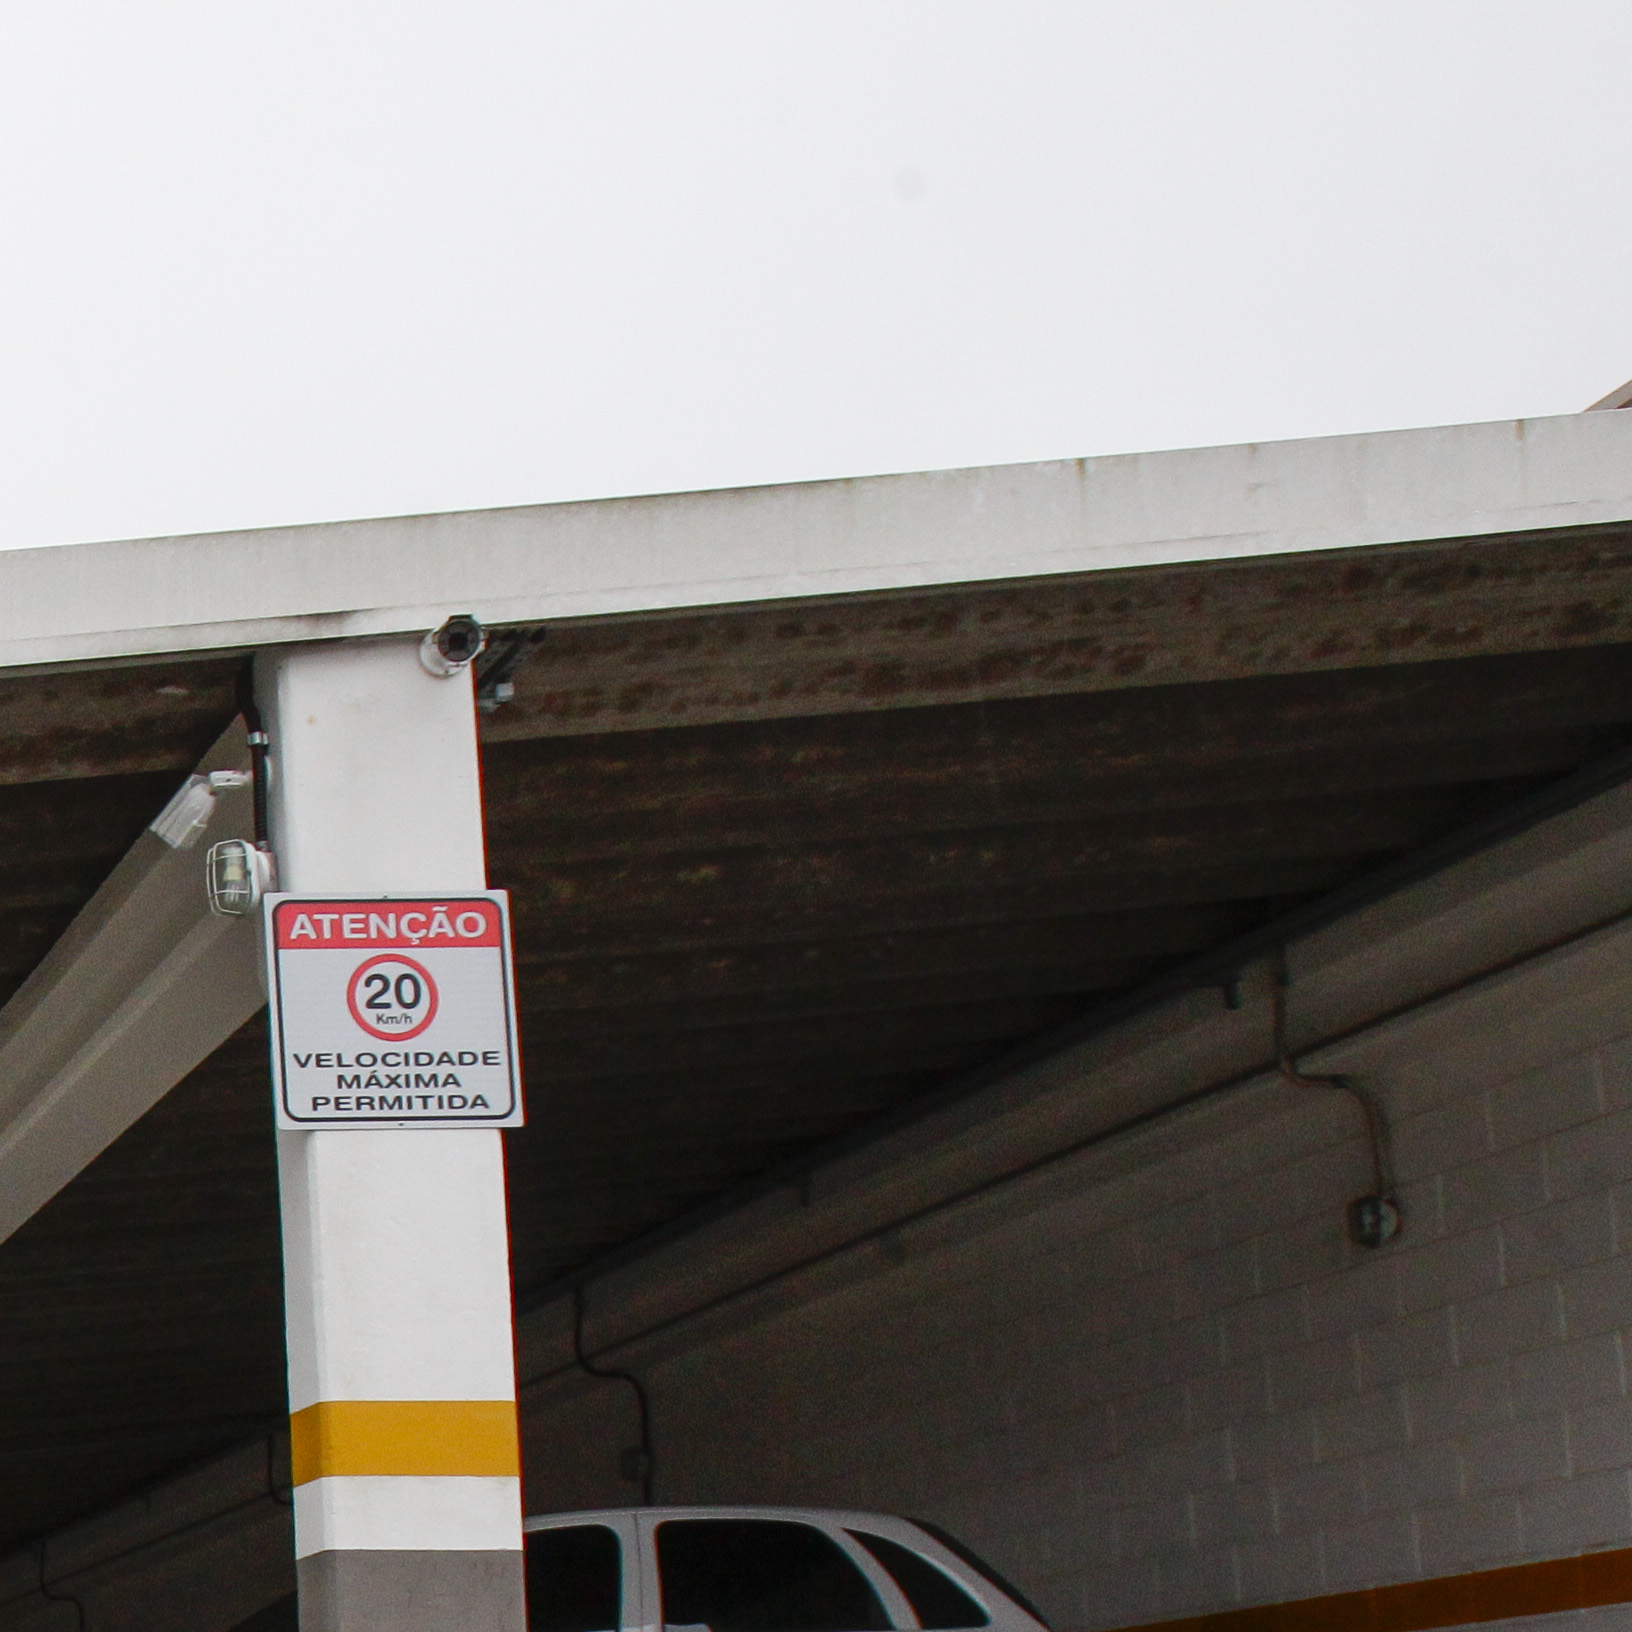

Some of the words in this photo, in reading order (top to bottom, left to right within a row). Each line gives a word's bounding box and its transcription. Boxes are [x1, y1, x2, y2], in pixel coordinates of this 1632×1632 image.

[289, 905, 487, 945] ATENÇÃO
[363, 973, 422, 1010] 20
[375, 1013, 413, 1025] Km/h
[292, 1051, 501, 1068] VELOCIDADE
[336, 1070, 462, 1089] MÁXIMA
[311, 1094, 490, 1112] PERMITIDA
